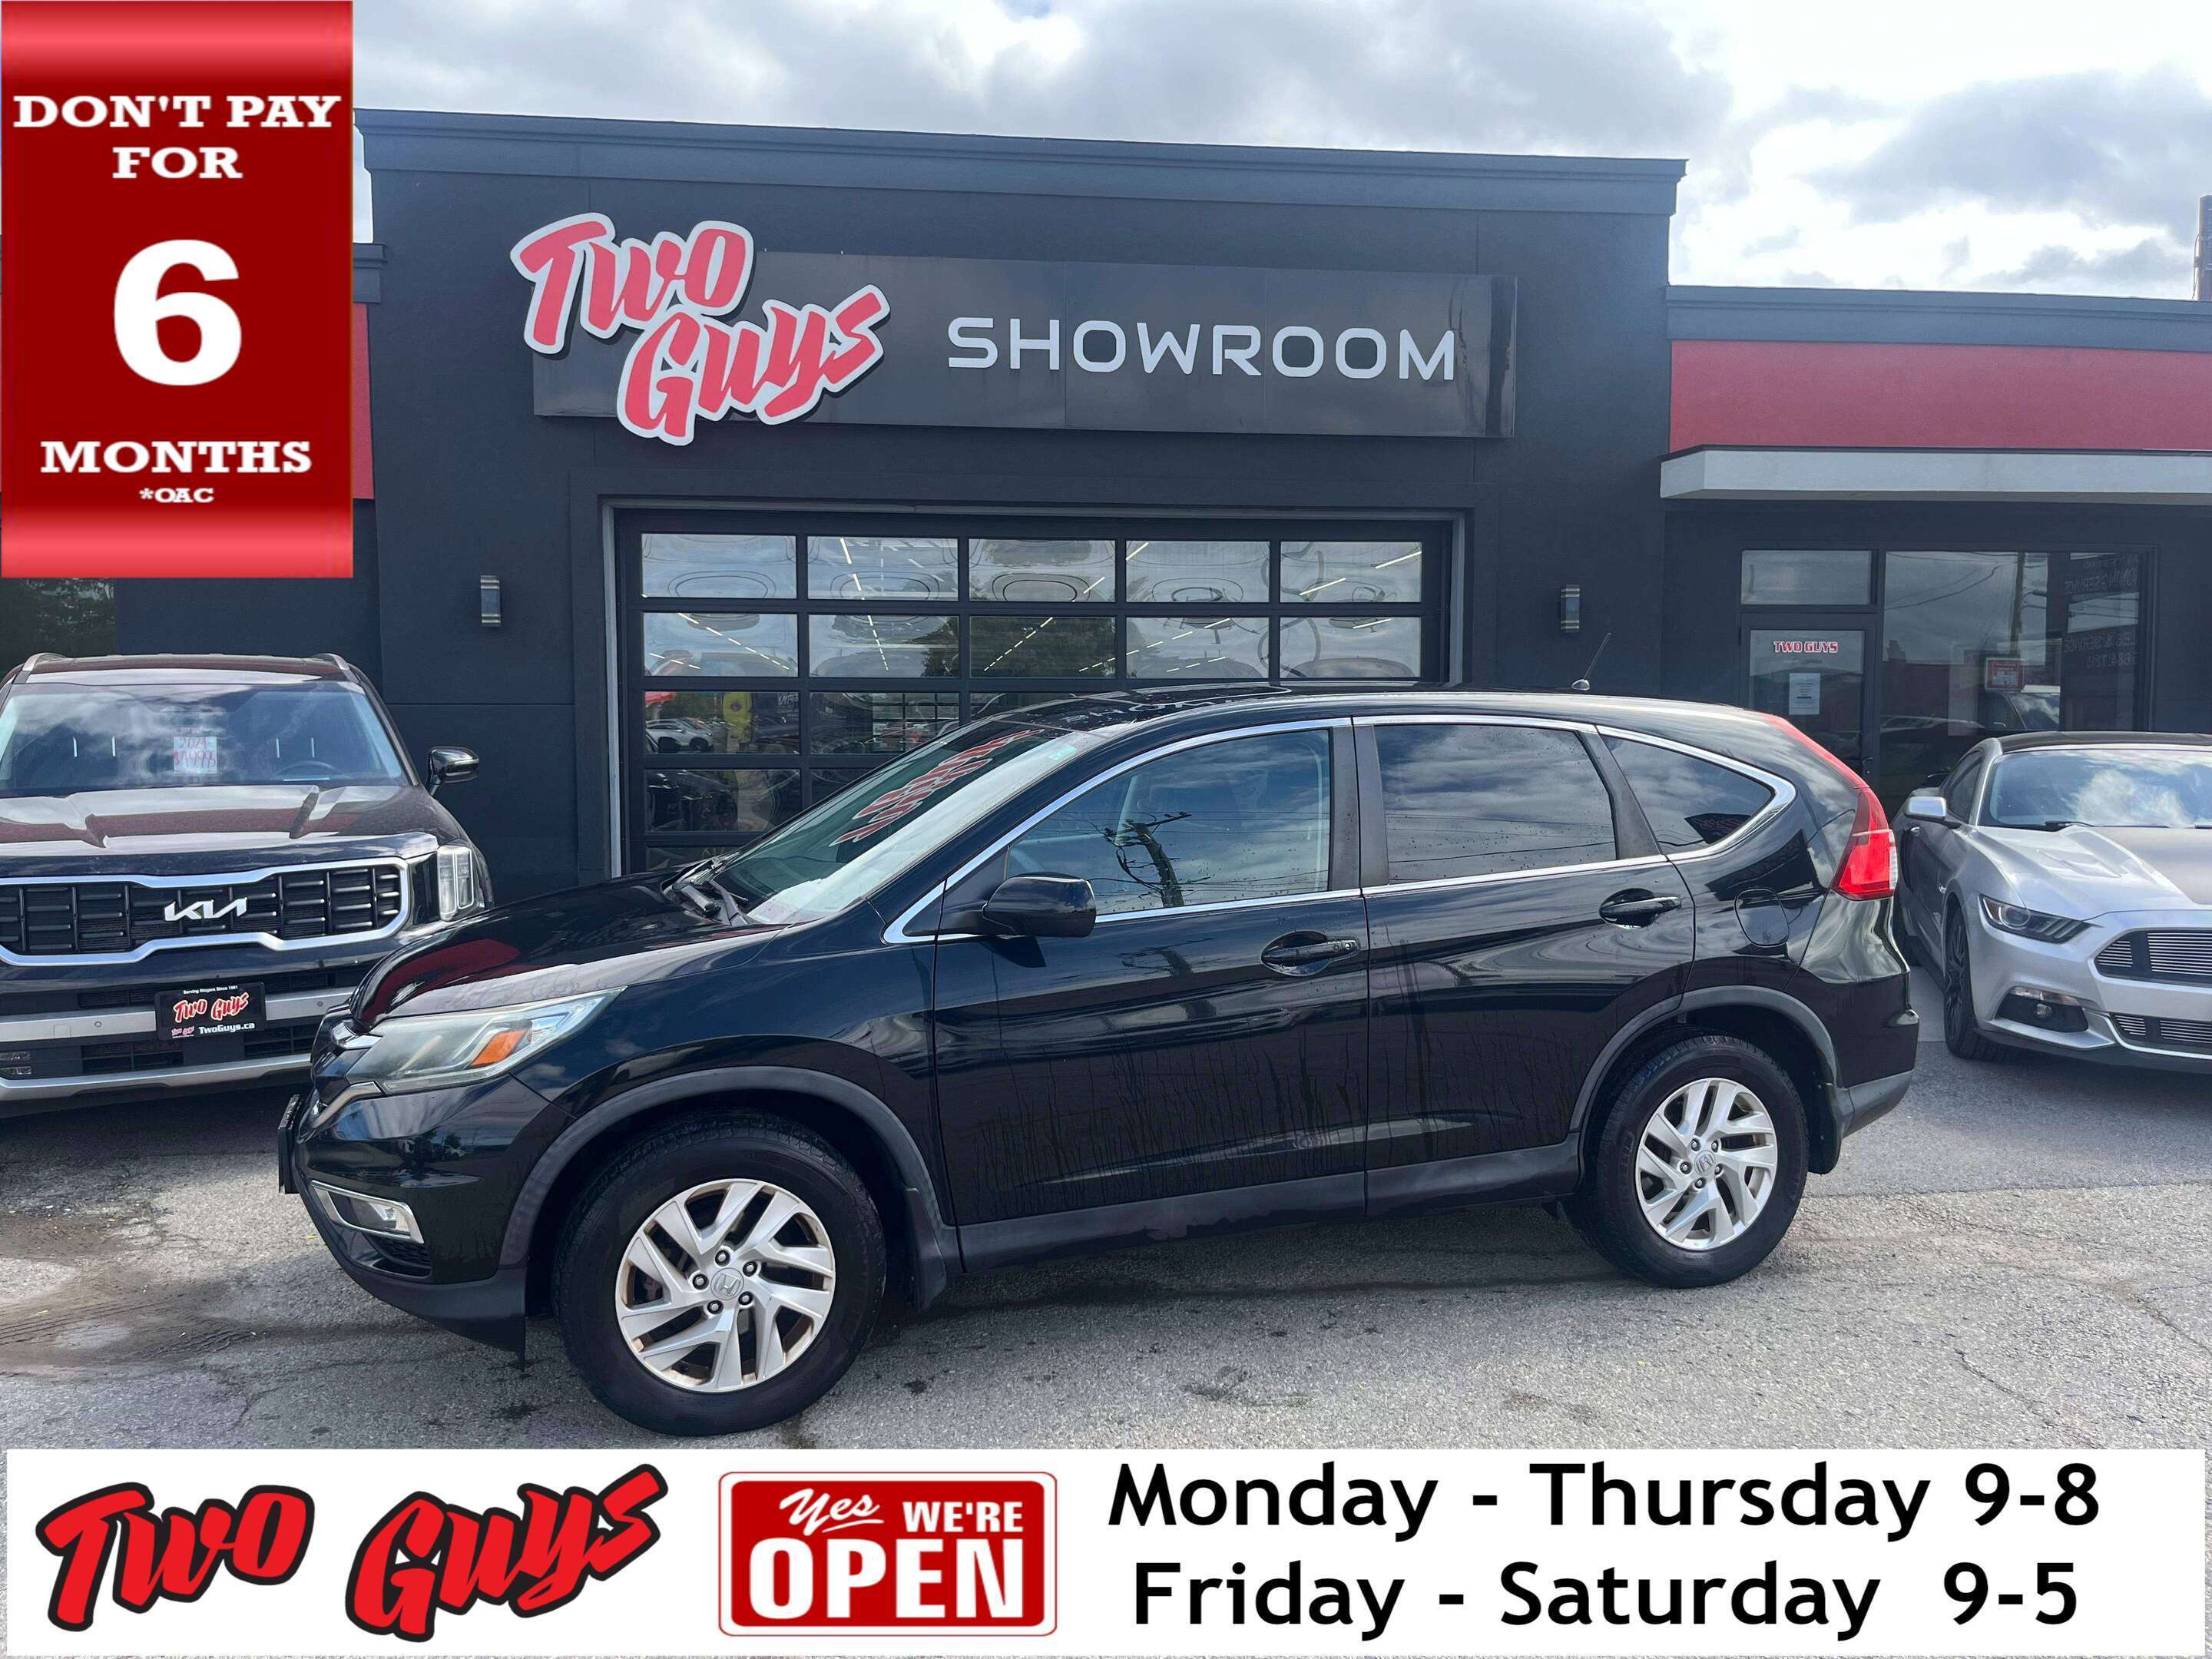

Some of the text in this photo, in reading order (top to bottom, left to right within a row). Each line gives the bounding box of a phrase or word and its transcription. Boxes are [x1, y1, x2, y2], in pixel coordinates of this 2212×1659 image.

[510, 212, 754, 354] Two
[617, 284, 890, 446] Guys
[949, 316, 1455, 382] SHOWROOM
[1773, 641, 1839, 653] TWO GUYS
[173, 992, 249, 1023] Two Guys
[198, 1022, 255, 1035] TwoGuys.ca
